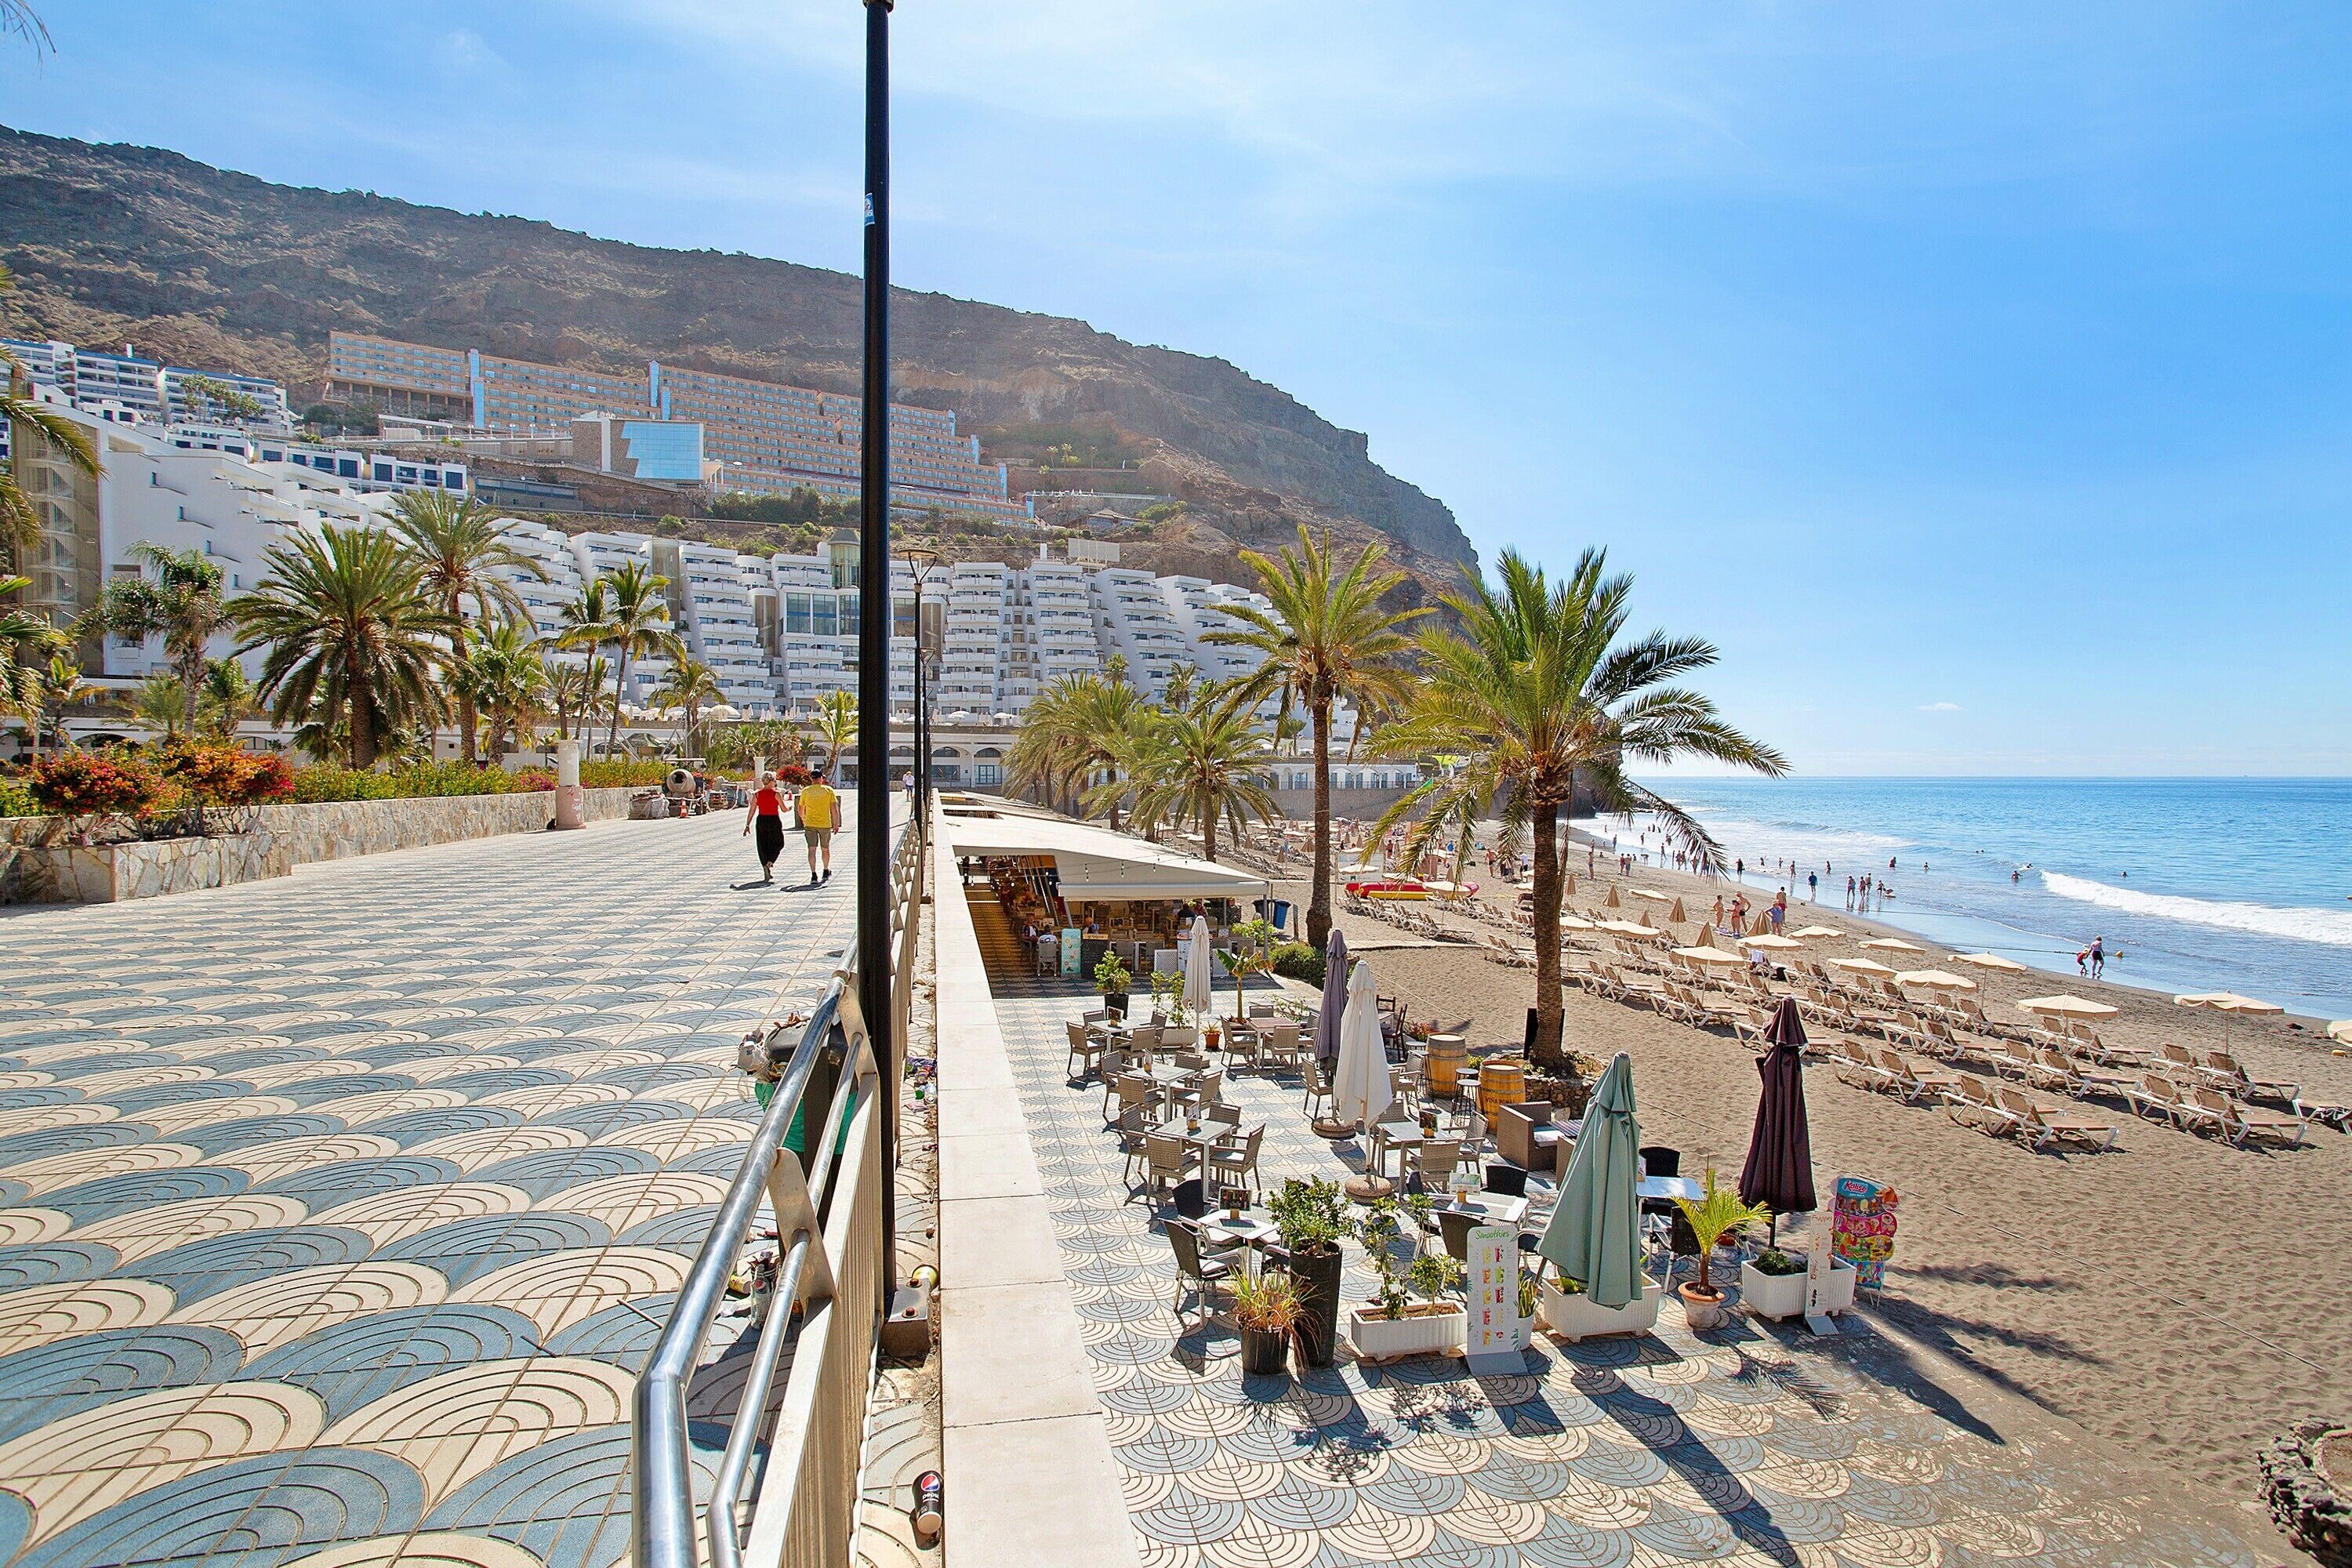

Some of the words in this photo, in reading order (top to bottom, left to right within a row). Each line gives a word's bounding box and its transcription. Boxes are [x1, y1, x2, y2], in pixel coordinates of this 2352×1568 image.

[1485, 1095, 1498, 1104] VIÑA
[1844, 1180, 1867, 1193] Kalise
[1475, 1229, 1510, 1240] Smoothies
